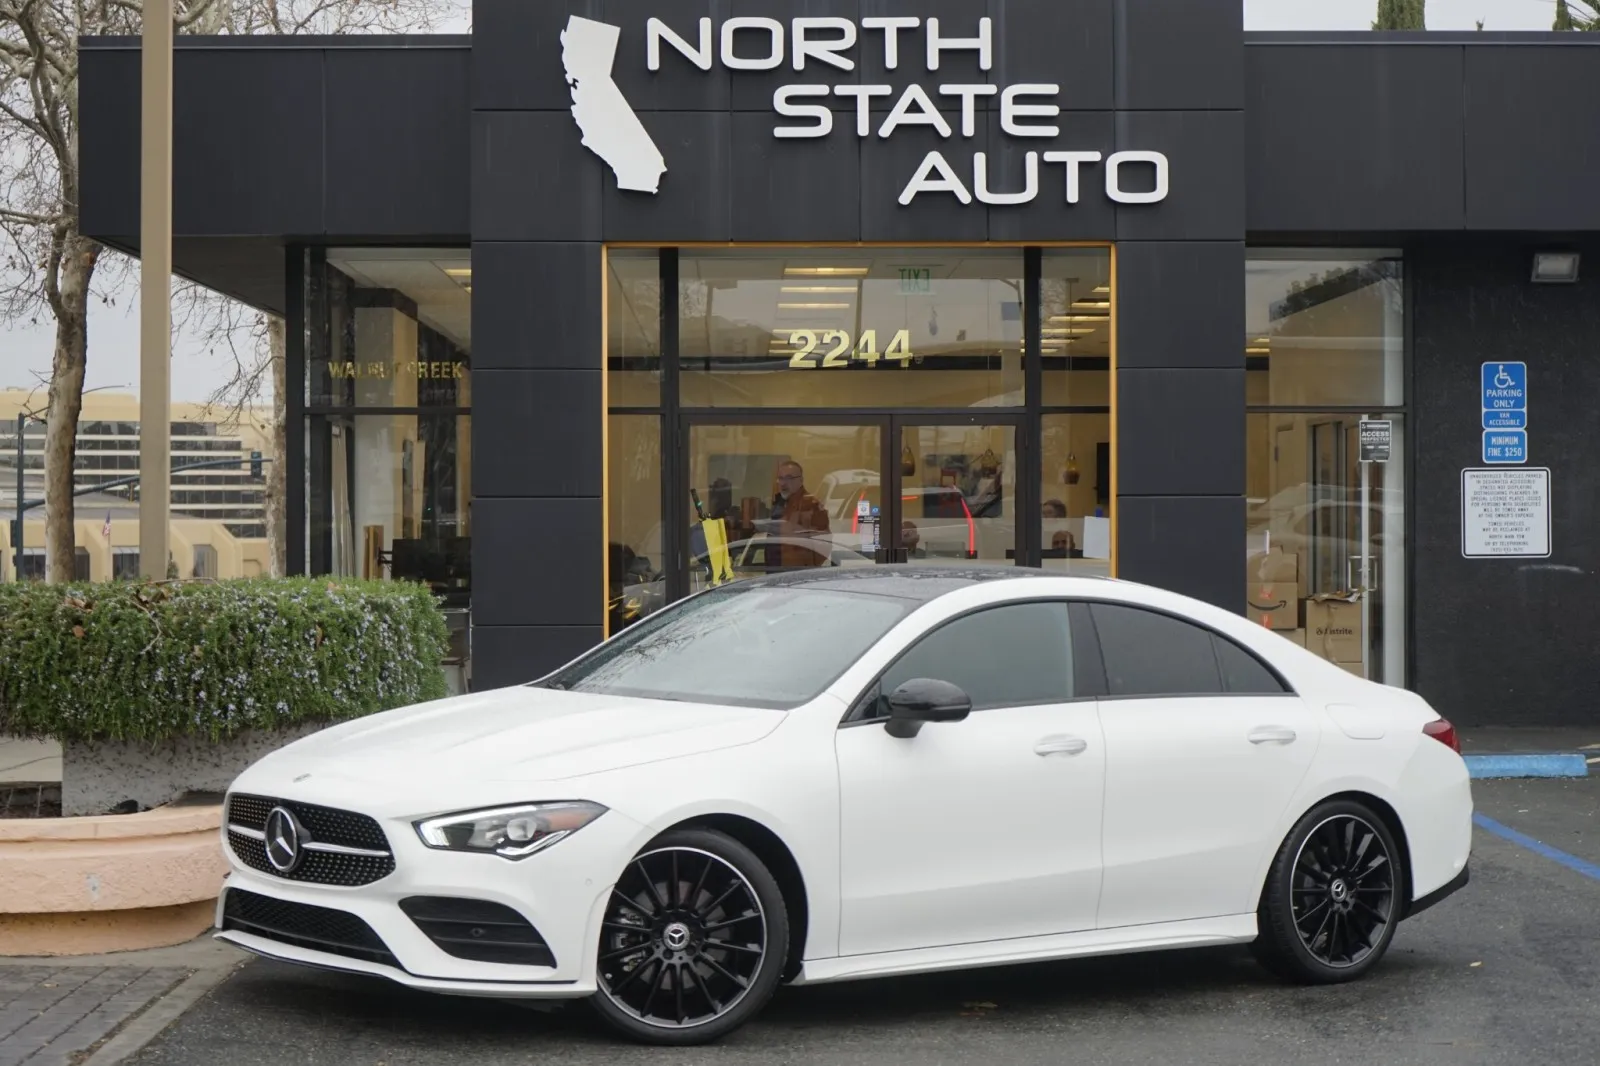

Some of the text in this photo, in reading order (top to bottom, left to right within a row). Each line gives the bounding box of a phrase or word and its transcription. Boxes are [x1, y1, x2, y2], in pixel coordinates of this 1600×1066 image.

[646, 16, 993, 72] NORTH
[772, 83, 1060, 139] STATE
[898, 150, 1169, 206] AUTO
[788, 329, 913, 368] 2244
[406, 361, 463, 379] CREEK
[1486, 389, 1523, 398] PARKING
[1493, 400, 1515, 408] ONLY
[1491, 436, 1519, 445] MINIMUM
[1487, 447, 1522, 457] FINE $250
